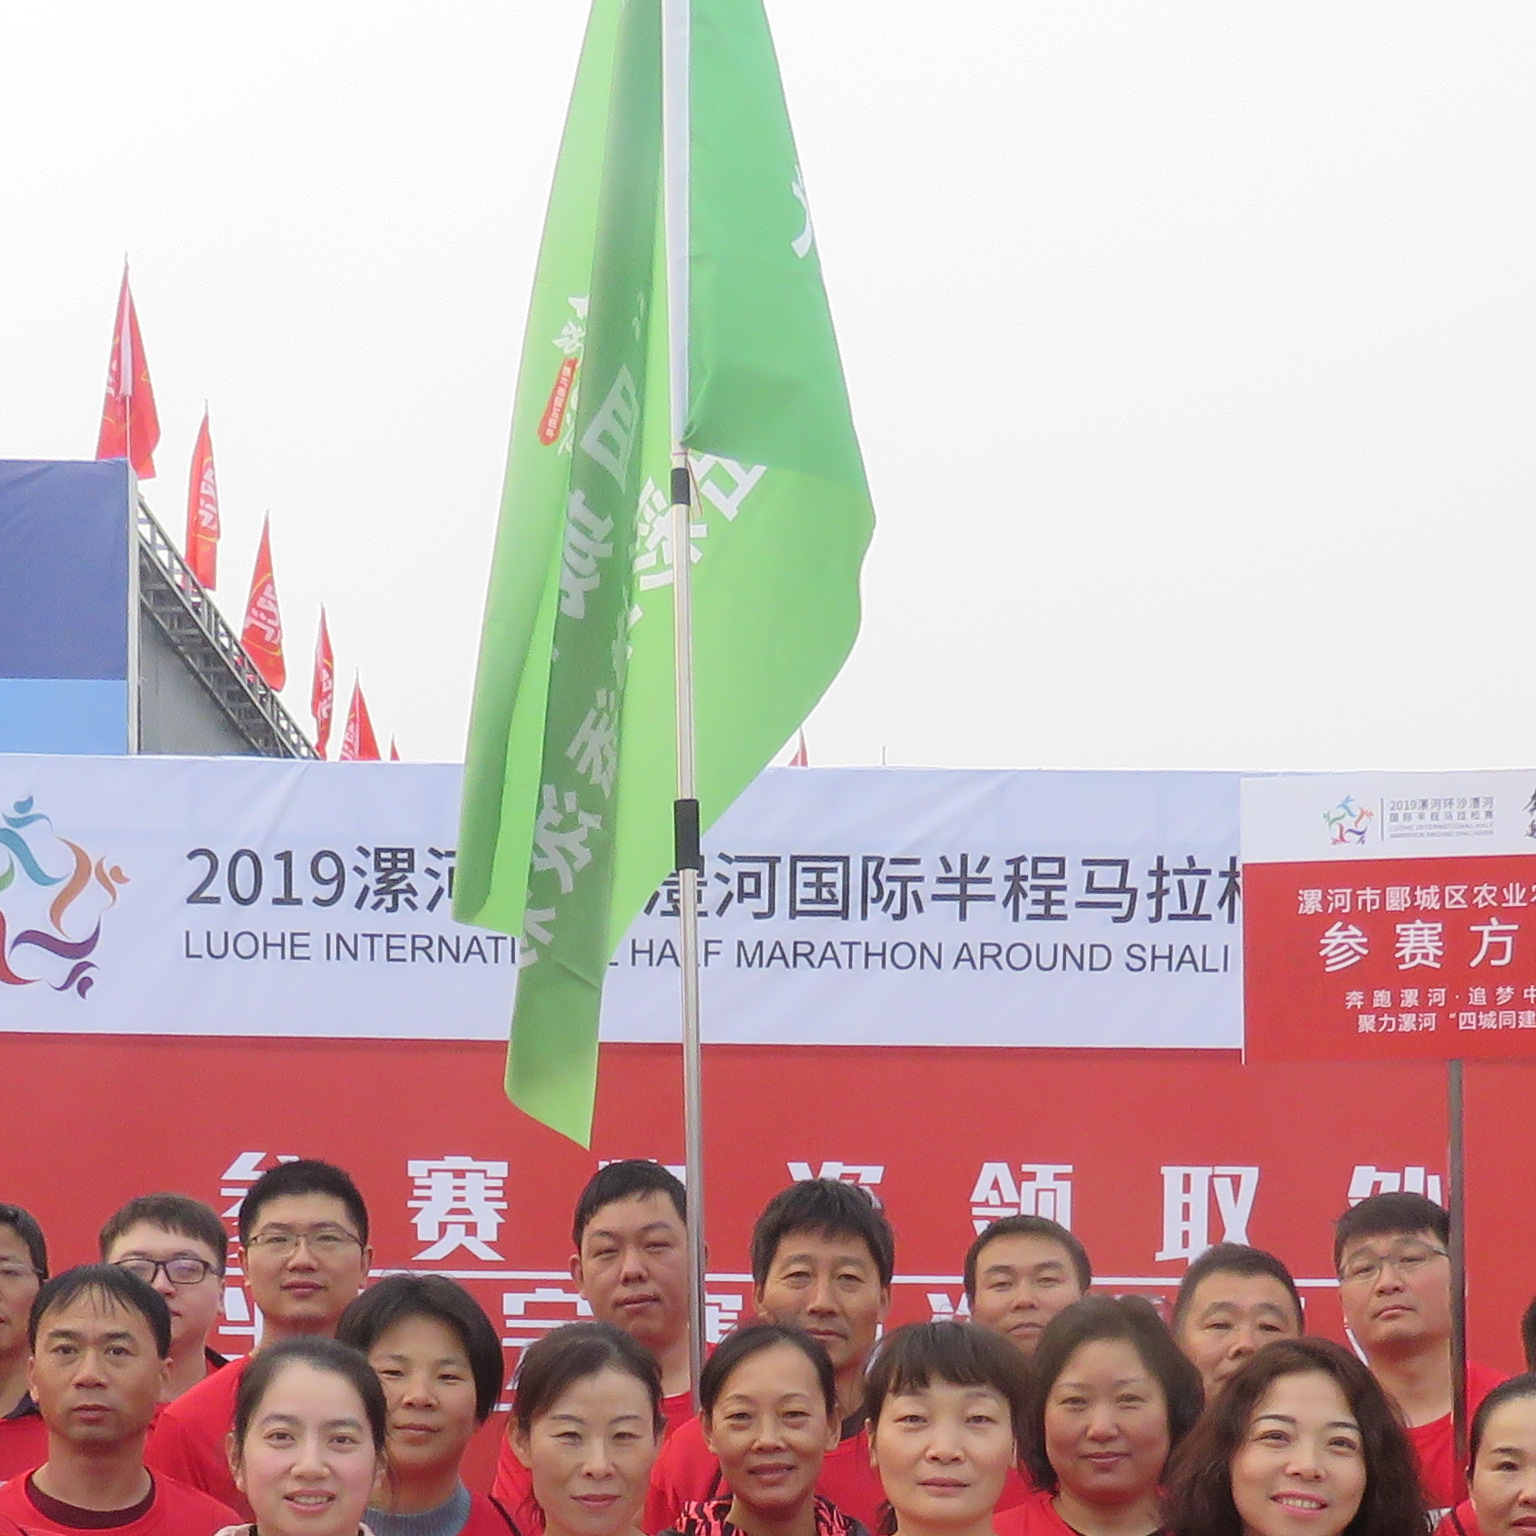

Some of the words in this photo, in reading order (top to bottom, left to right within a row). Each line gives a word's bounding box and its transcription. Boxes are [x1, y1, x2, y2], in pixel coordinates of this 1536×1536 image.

[183, 931, 312, 962] LUOHE
[325, 932, 517, 966] INTERNATI
[630, 938, 721, 969] HAF
[735, 940, 942, 971] MARATHON
[953, 941, 1112, 972] AROUND
[1124, 943, 1231, 973] SHALI
[1357, 1011, 1437, 1034] 聚力漯河
